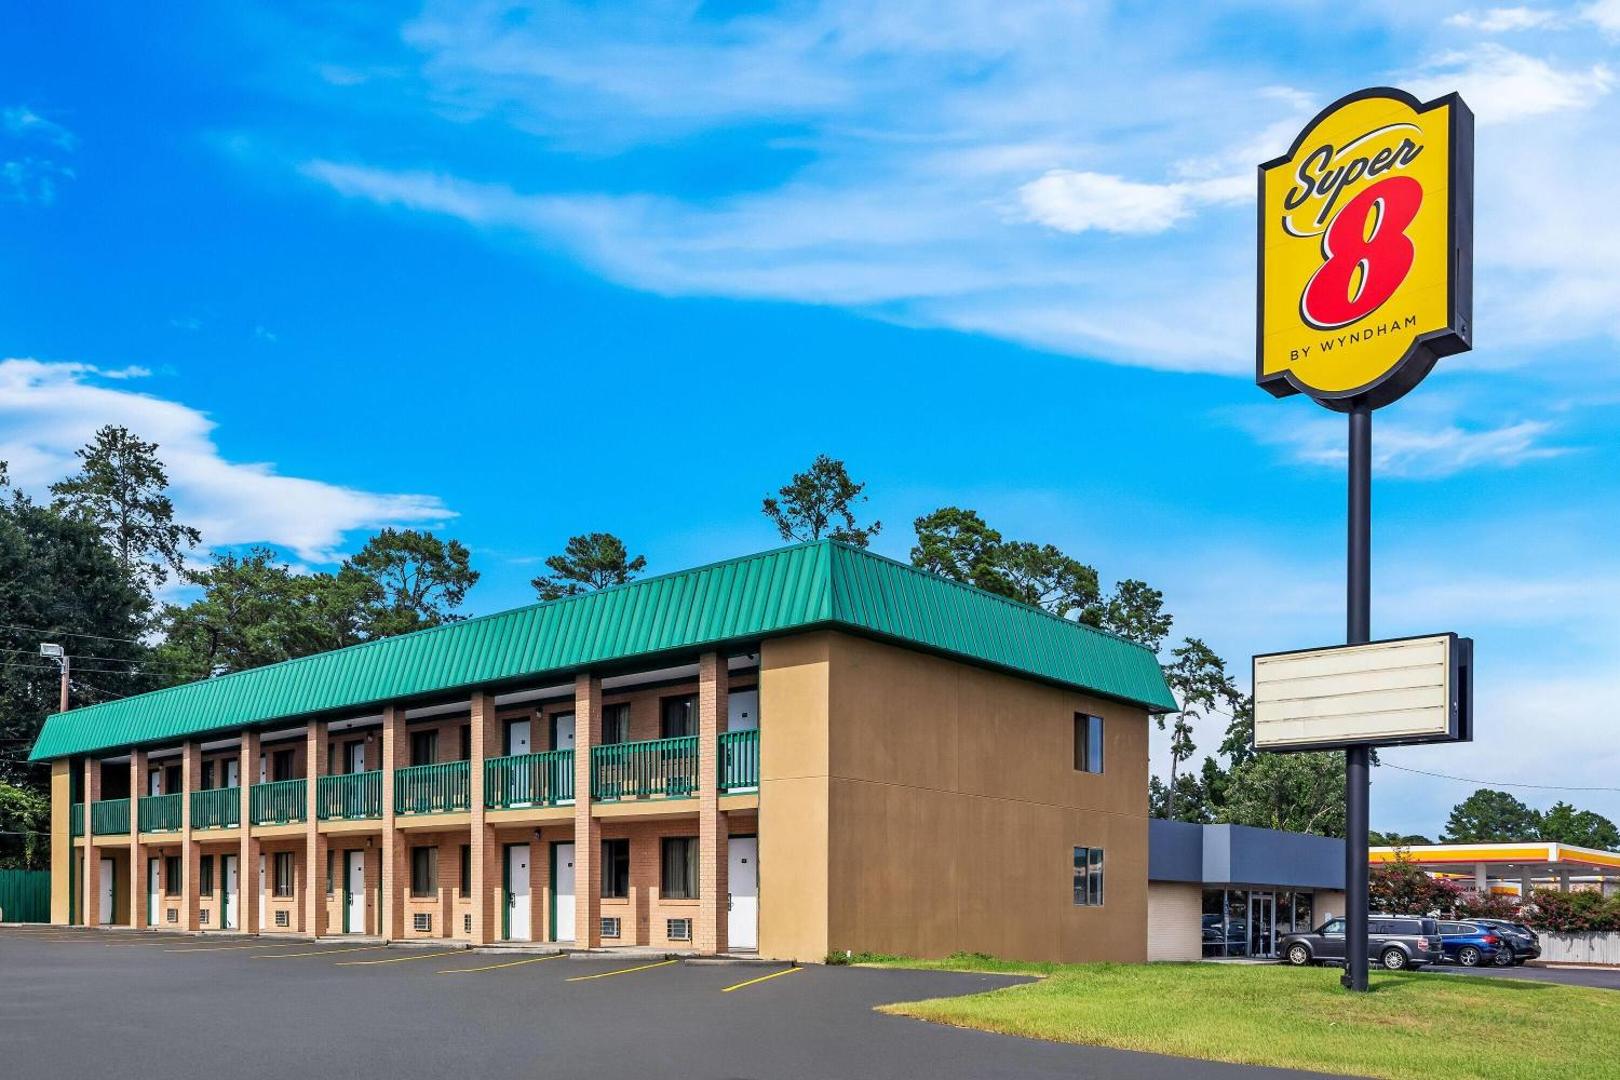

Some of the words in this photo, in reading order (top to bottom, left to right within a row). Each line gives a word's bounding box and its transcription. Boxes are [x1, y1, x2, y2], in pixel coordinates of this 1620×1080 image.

[1283, 137, 1424, 227] Super
[1299, 175, 1424, 332] 8
[1290, 346, 1311, 361] BY
[1320, 315, 1417, 352] WYNDHAM
